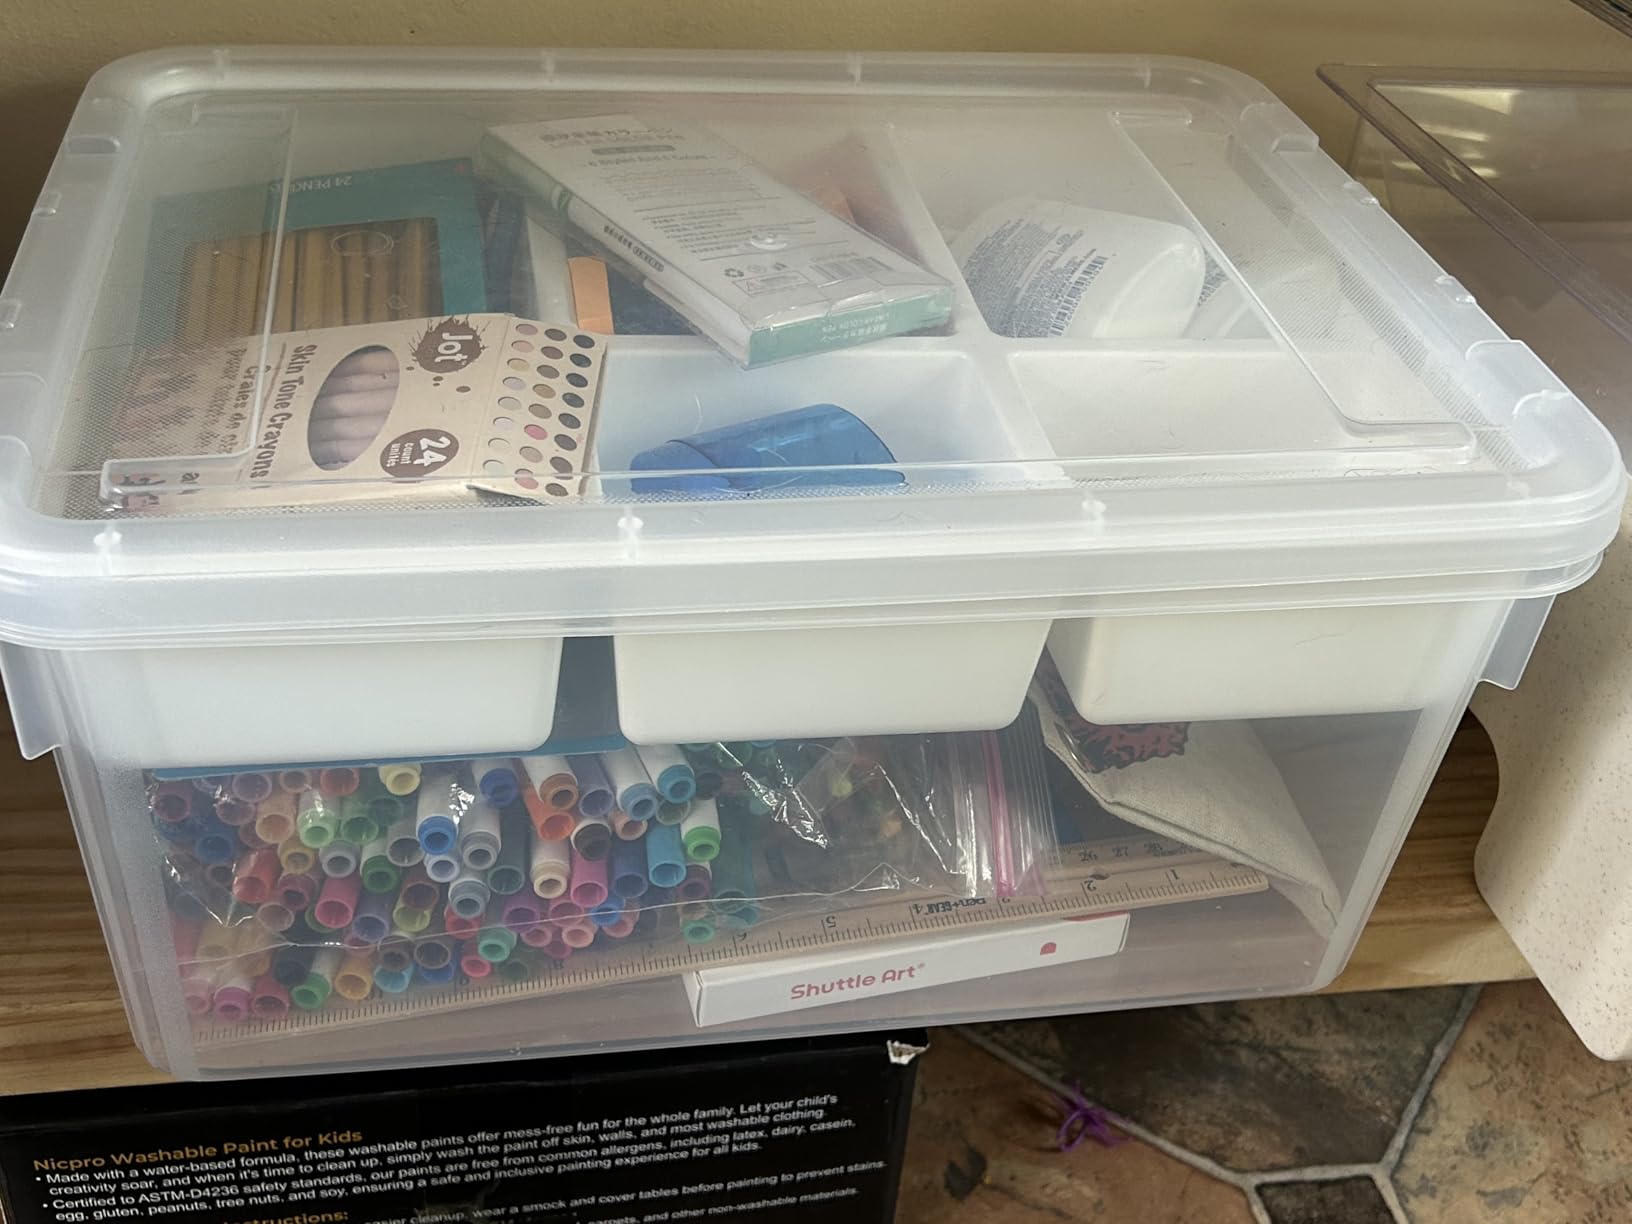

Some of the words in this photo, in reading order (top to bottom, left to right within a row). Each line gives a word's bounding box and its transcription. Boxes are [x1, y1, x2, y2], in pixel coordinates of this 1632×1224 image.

[285, 344, 318, 375] Skin
[434, 332, 474, 363] Jot
[273, 375, 305, 410] Tone
[249, 412, 293, 479] Crayons
[400, 442, 415, 465] count
[413, 436, 451, 467] 24
[1083, 880, 1097, 892] 2
[1170, 869, 1180, 881] 1
[824, 915, 837, 928] 5
[913, 903, 923, 915] 4
[790, 974, 876, 1000] Shuttle
[881, 965, 915, 984] Art
[33, 1157, 106, 1172] Nicpro
[110, 1145, 218, 1165] Washable
[223, 1139, 279, 1155] Paint
[282, 1135, 312, 1149] for
[318, 1130, 363, 1146] Kids
[45, 1172, 90, 1184] Made
[93, 1169, 125, 1180] with
[129, 1169, 139, 1178] a
[142, 1157, 236, 1176] water-based
[239, 1152, 300, 1168] formula,
[304, 1148, 345, 1161] these
[348, 1139, 418, 1156] washable
[421, 1135, 465, 1150] paints
[467, 1131, 500, 1144] offer
[503, 1124, 574, 1139] mess-free
[577, 1121, 600, 1132] fun
[602, 1118, 622, 1129] for
[624, 1116, 648, 1127] the
[649, 1111, 691, 1124] whole
[693, 1106, 734, 1120] family.
[739, 1102, 762, 1115] Let
[764, 1100, 795, 1114] your
[796, 1094, 838, 1108] child's
[49, 1182, 117, 1196] creativity
[121, 1179, 158, 1191] soar,
[162, 1175, 191, 1187] and
[194, 1172, 236, 1184] when
[239, 1169, 260, 1180] it's
[263, 1166, 295, 1178] time
[298, 1164, 314, 1174] to
[316, 1160, 357, 1172] clean
[360, 1157, 383, 1169] up,
[386, 1150, 433, 1165] simply
[435, 1146, 474, 1159] wash
[477, 1144, 501, 1155] the
[503, 1139, 538, 1154] paint
[541, 1136, 560, 1148] off
[562, 1134, 595, 1146] skin,
[598, 1129, 637, 1142] walls,
[640, 1125, 667, 1138] and
[669, 1121, 704, 1135] most
[706, 1114, 771, 1130] washable
[52, 1196, 117, 1209] Certified
[119, 1195, 136, 1205] to
[138, 1184, 240, 1204] ASTM-D4236
[242, 1181, 288, 1194] safety
[290, 1172, 367, 1189] standards,
[370, 1169, 395, 1181] our
[398, 1165, 442, 1180] paints
[444, 1162, 468, 1173] are
[471, 1159, 500, 1170] free
[502, 1155, 535, 1166] from
[537, 1148, 598, 1163] common
[600, 1141, 667, 1156] allergens,
[669, 1133, 731, 1149] including
[809, 1118, 856, 1132] casein,
[55, 1211, 89, 1222] egg,
[92, 1207, 144, 1221] gluten,
[147, 1201, 212, 1217] peanuts,
[215, 1198, 245, 1209] tree
[248, 1194, 285, 1205] nuts,
[288, 1189, 316, 1201] and
[319, 1187, 349, 1198] soy,
[351, 1180, 414, 1195] ensuring
[417, 1178, 427, 1188] a
[430, 1174, 461, 1186] safe
[463, 1170, 491, 1183] and
[494, 1165, 555, 1179] inclusive
[557, 1158, 612, 1174] painting
[614, 1150, 690, 1166] experience
[691, 1147, 711, 1158] for
[712, 1142, 730, 1155] all
[731, 1141, 761, 1153] kids.
[471, 1207, 506, 1219] wear
[522, 1199, 567, 1213] smock
[569, 1195, 596, 1207] and
[598, 1192, 637, 1204] cover
[638, 1187, 679, 1200] tables
[681, 1182, 725, 1195] before
[726, 1175, 779, 1191] painting
[780, 1173, 795, 1182] to
[795, 1165, 845, 1182] prevent
[643, 1211, 669, 1223] and
[670, 1208, 706, 1219] other
[707, 1196, 798, 1215] non-washable
